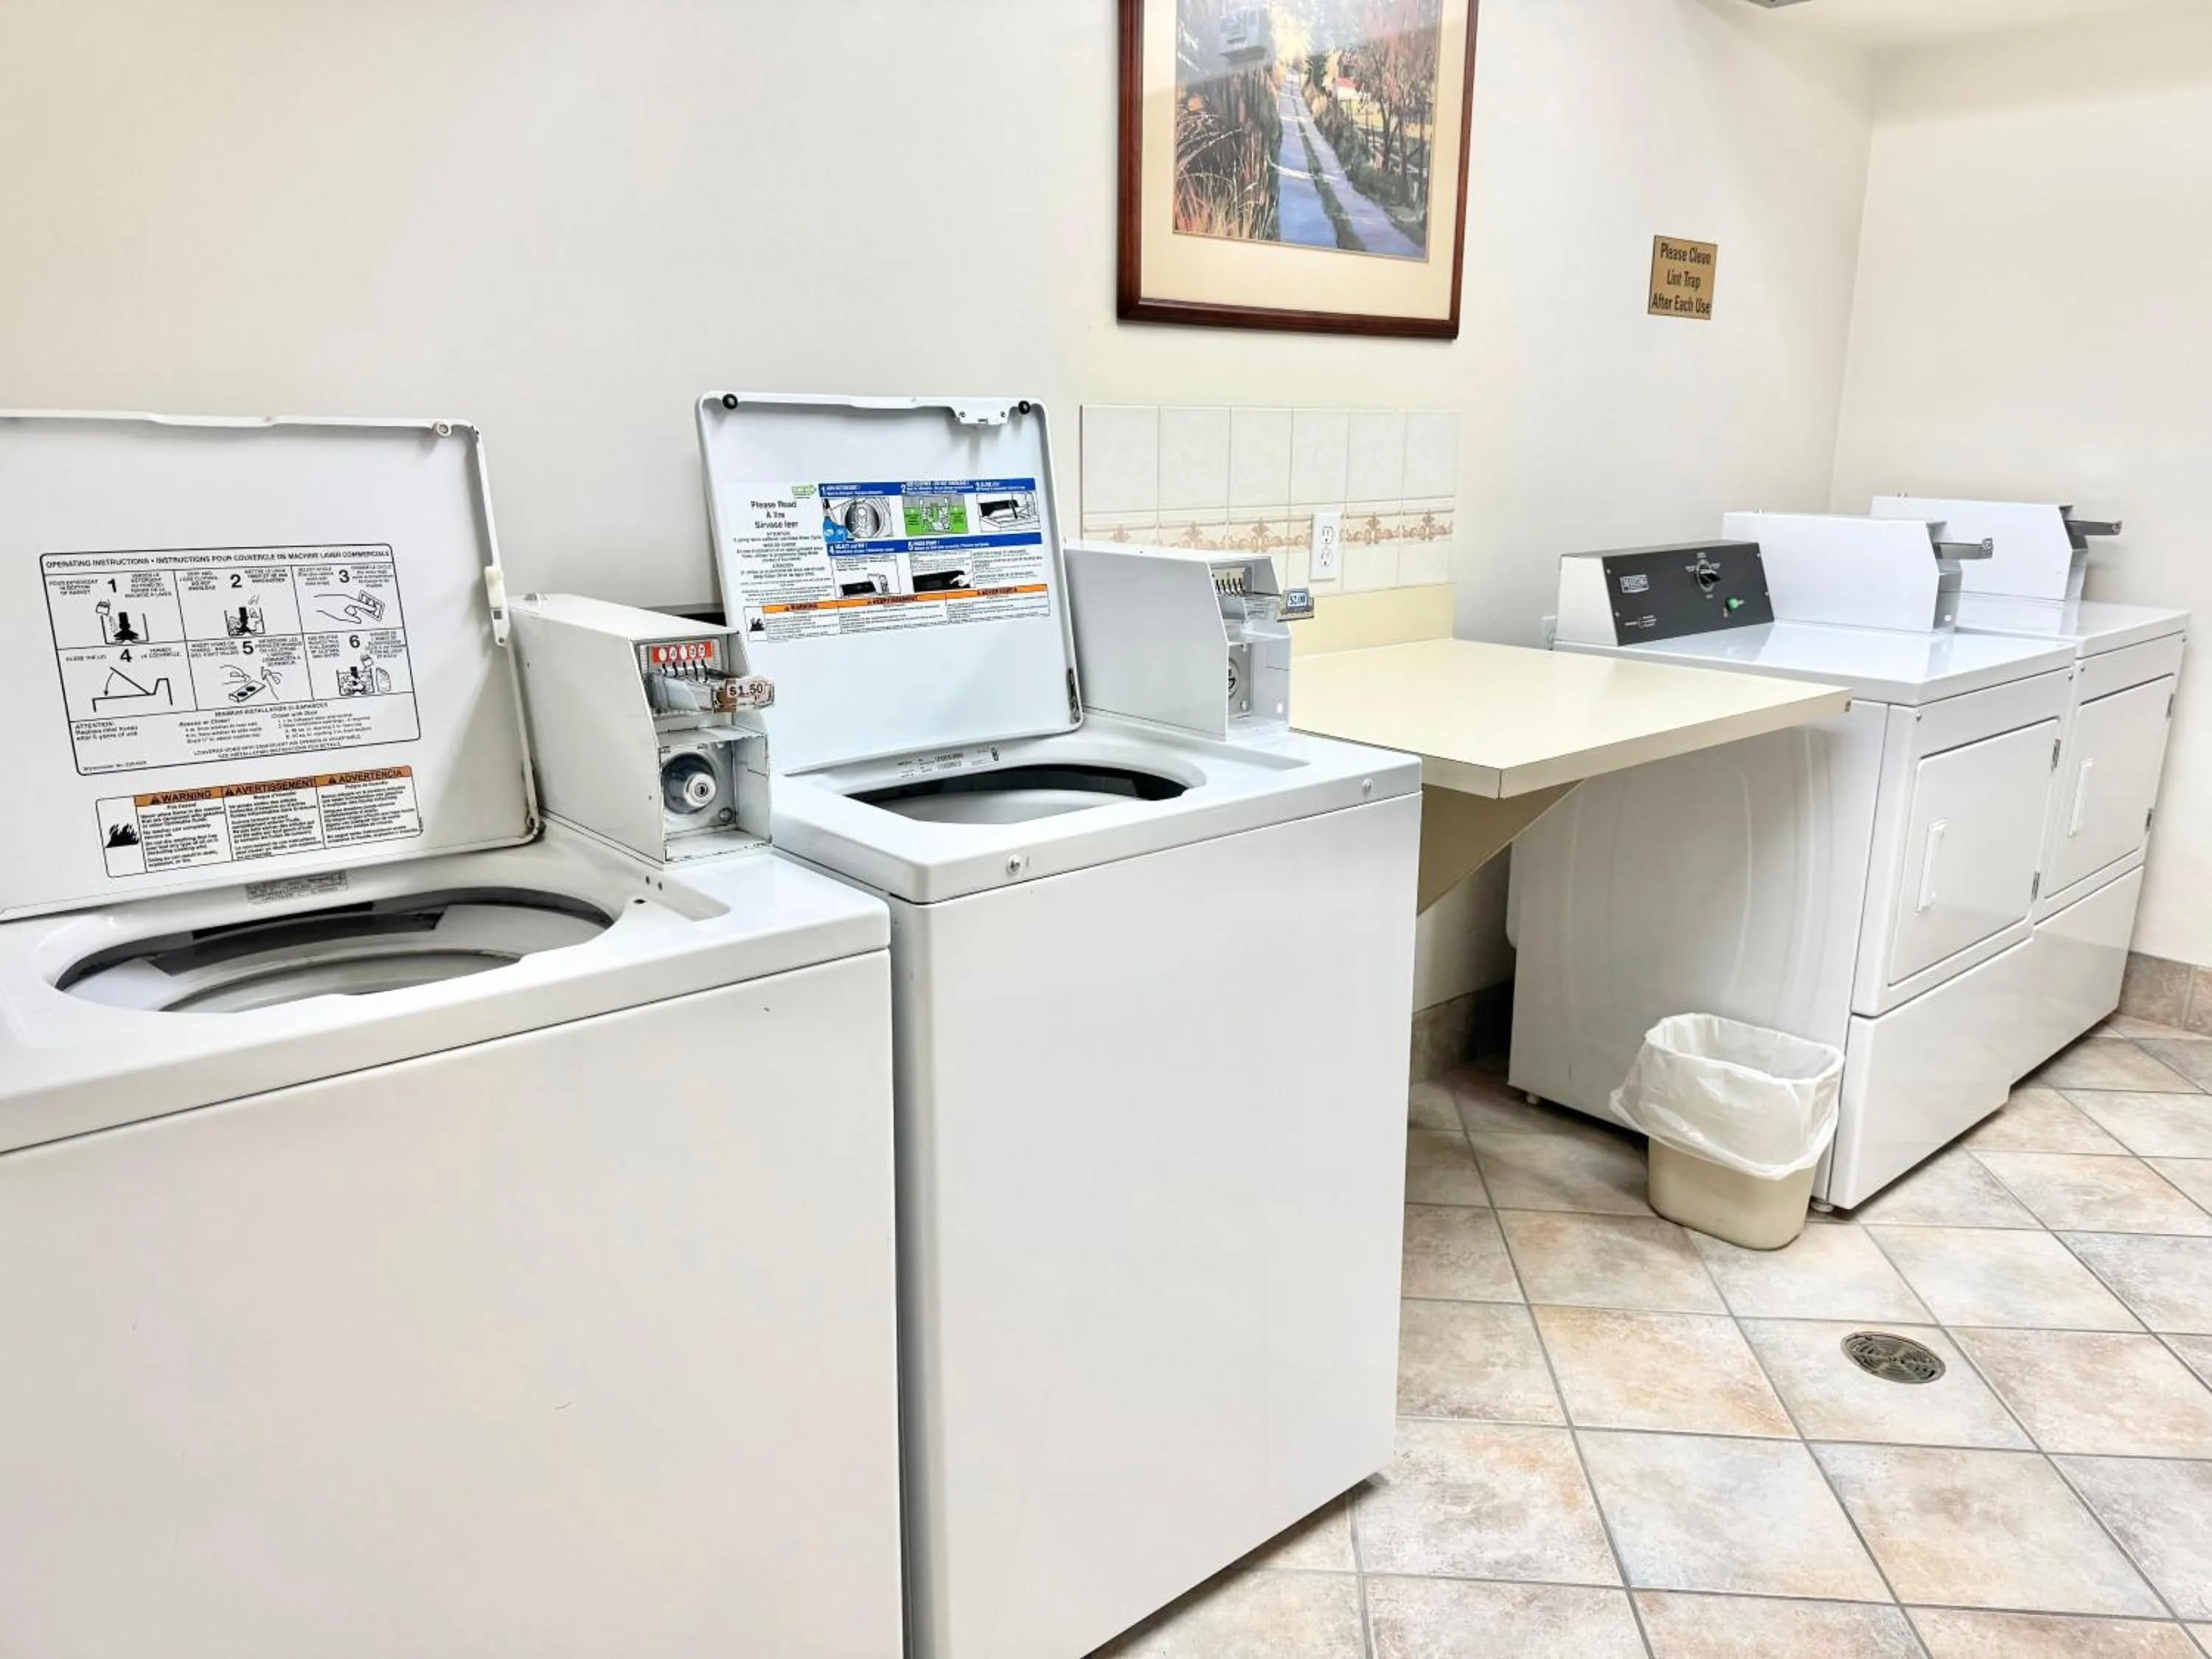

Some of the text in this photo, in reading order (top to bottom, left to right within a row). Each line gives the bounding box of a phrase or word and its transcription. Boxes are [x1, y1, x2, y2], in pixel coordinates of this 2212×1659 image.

[1660, 242, 1711, 265] Please Clean
[1666, 268, 1701, 293] Lint Trap
[1652, 293, 1711, 314] After Each Use
[46, 559, 91, 568] OPERATING
[92, 557, 150, 567] INSTRUCTIONS
[156, 556, 210, 564] INSTRUCTIONS
[212, 554, 232, 563] POUR
[229, 574, 243, 588] 2
[338, 568, 350, 583] 3
[107, 578, 117, 594] 1
[243, 641, 254, 655] 5
[349, 635, 361, 649] 6
[120, 648, 133, 663] 4
[728, 683, 764, 697] $1.50
[338, 769, 403, 784] ADVERTENCIA
[235, 779, 315, 795] AVERTISSEMENT
[161, 790, 212, 803] WARNING
